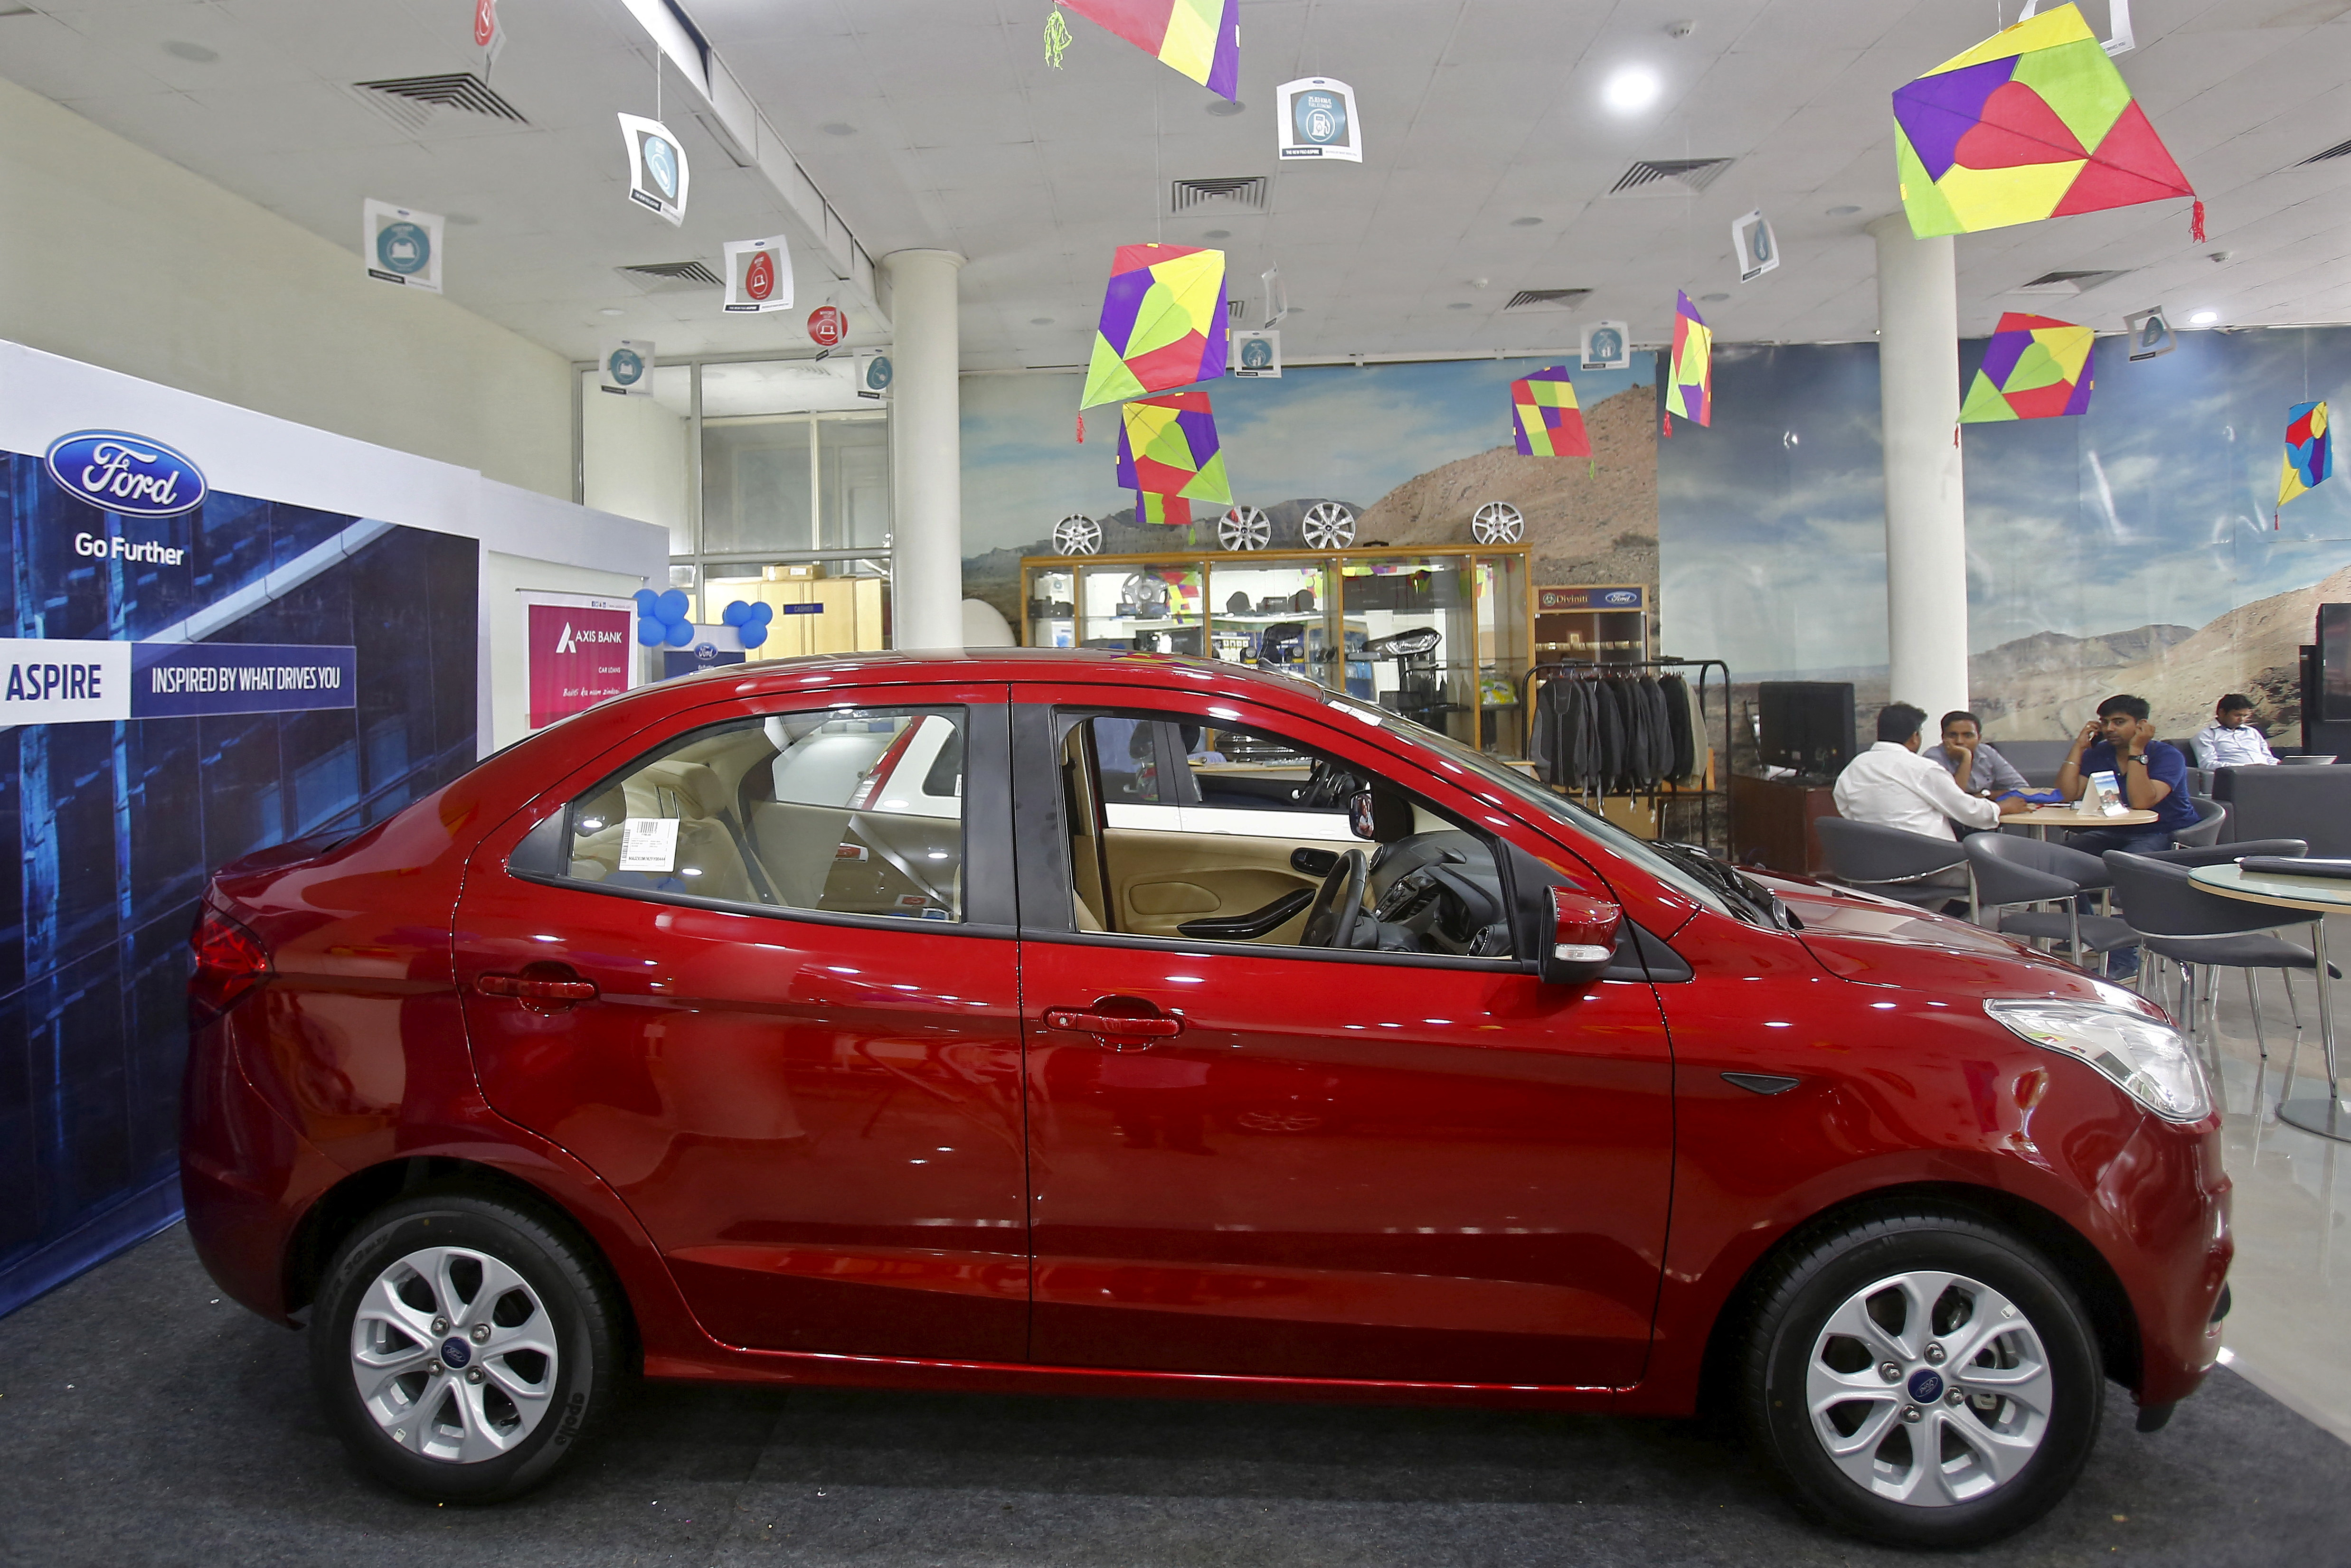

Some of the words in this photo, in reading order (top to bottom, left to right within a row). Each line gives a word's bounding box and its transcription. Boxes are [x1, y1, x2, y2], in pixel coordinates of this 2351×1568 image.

[82, 442, 180, 506] Ford
[75, 532, 108, 558] Go
[111, 535, 185, 566] Further
[1557, 594, 1588, 604] Diviniti
[1611, 593, 1631, 602] Ford
[575, 630, 596, 642] AXIS
[598, 631, 623, 643] BANK
[699, 646, 713, 657] Ford
[5, 664, 102, 701] ASPIRE
[151, 667, 218, 694] INSPIRED
[219, 667, 238, 692] BY
[238, 667, 276, 691] WHAT
[277, 666, 317, 691] DRIVES
[318, 666, 342, 690] YOU
[554, 1392, 585, 1445] apollo
